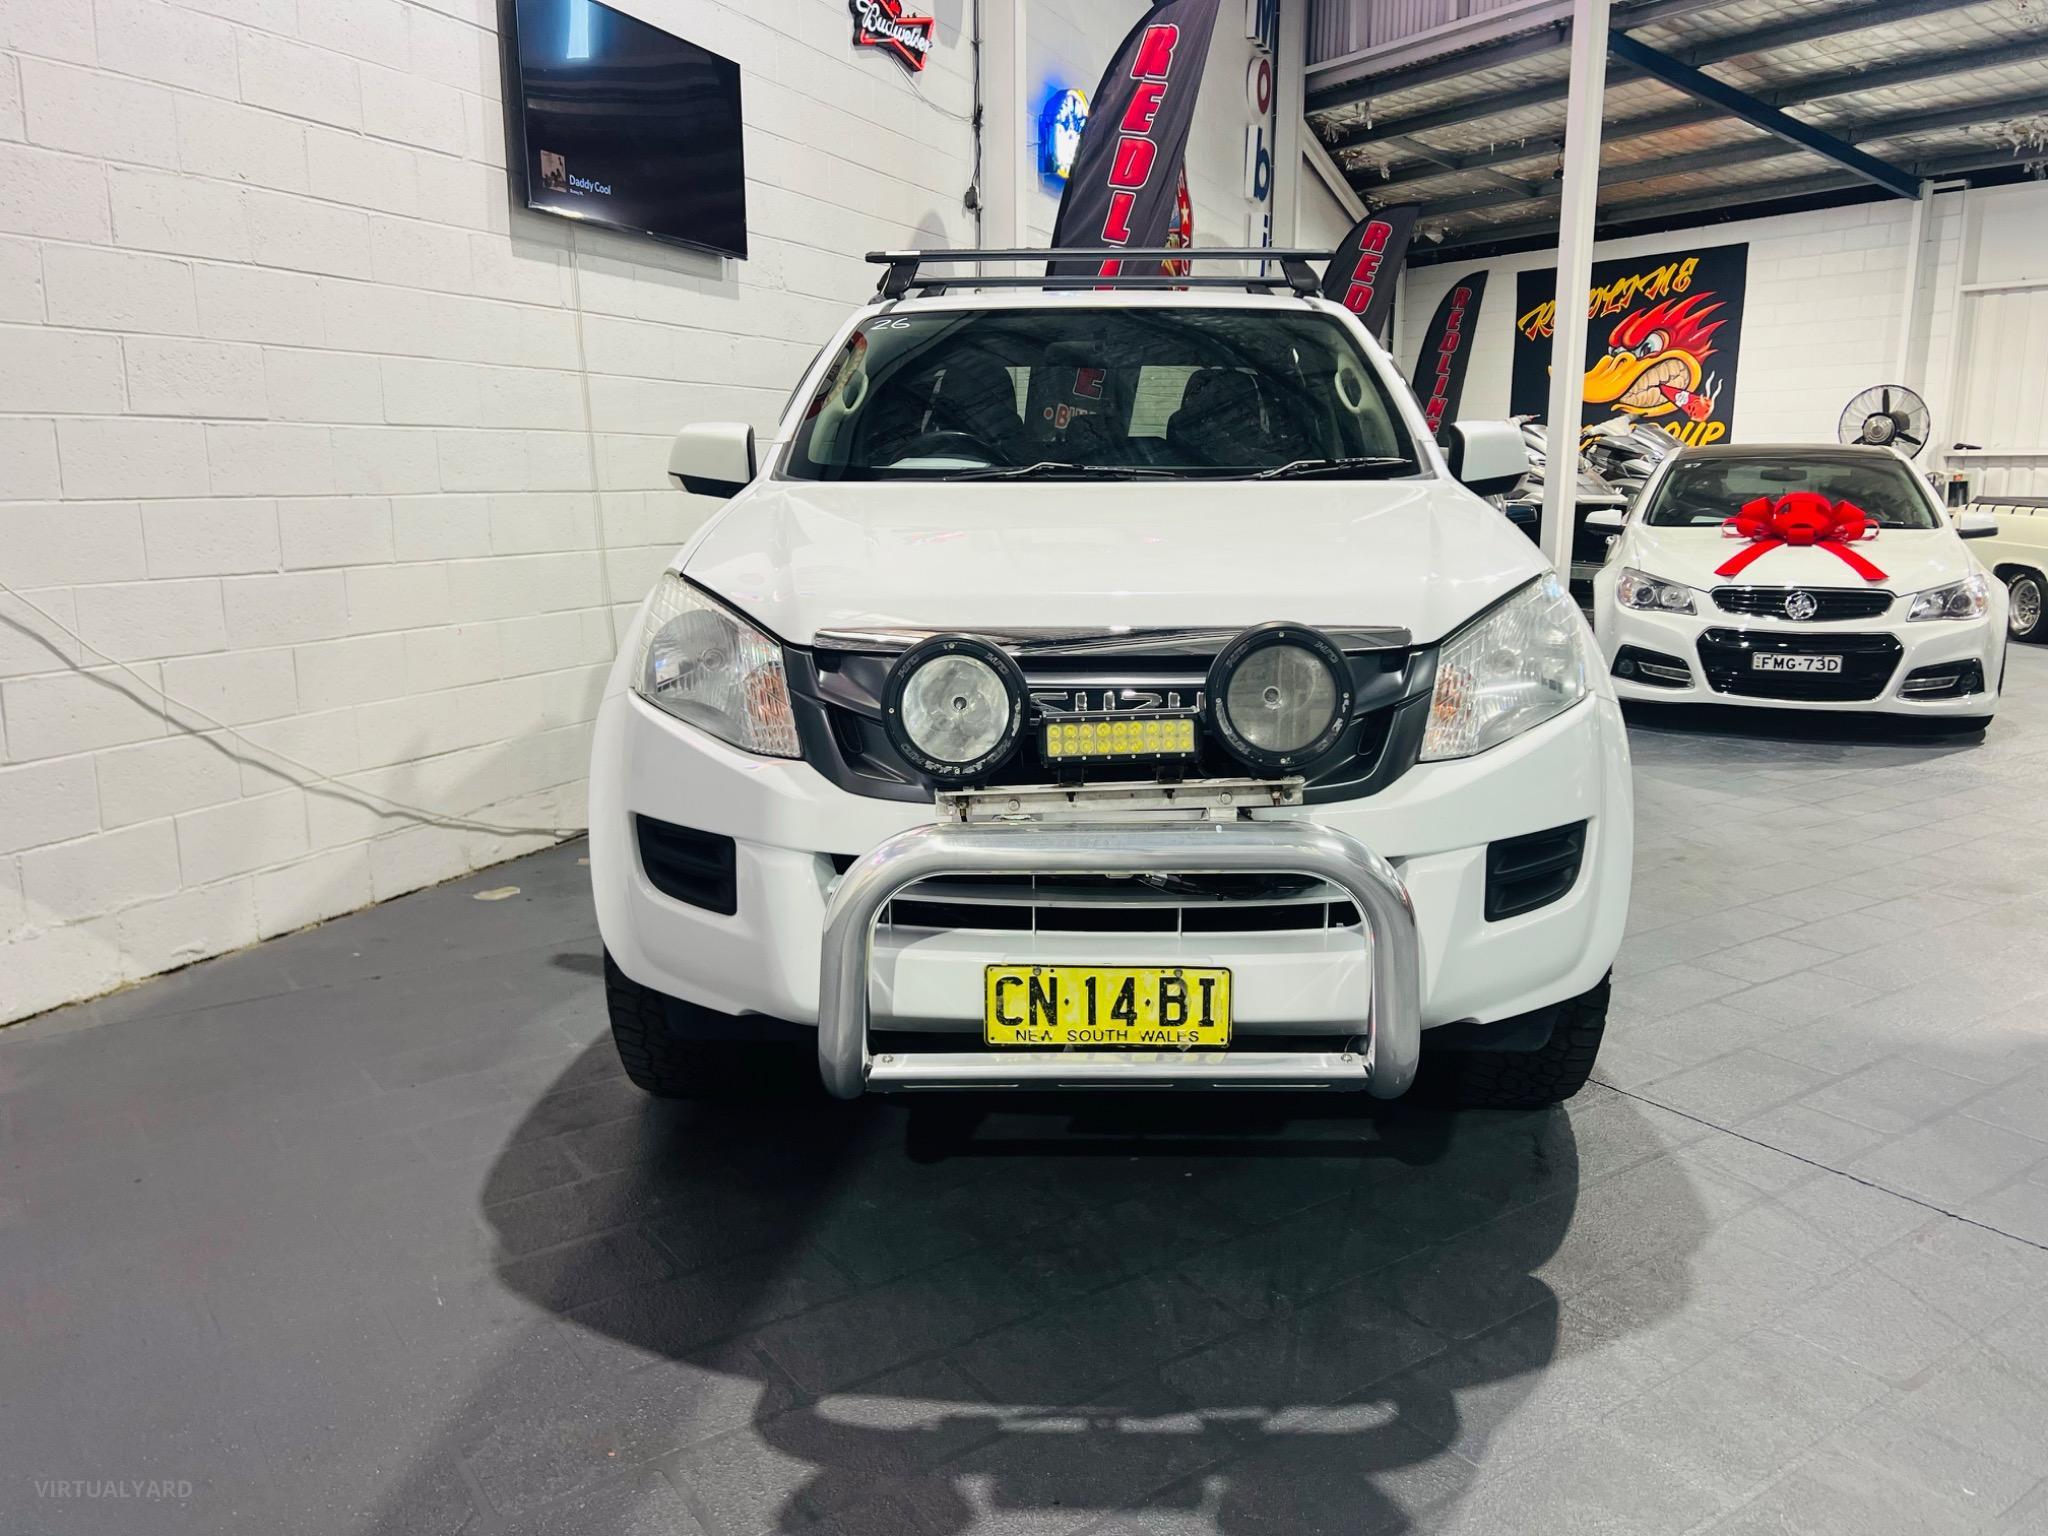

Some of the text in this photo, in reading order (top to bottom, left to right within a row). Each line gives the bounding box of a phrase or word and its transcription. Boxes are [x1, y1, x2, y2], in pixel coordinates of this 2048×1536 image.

[569, 174, 594, 192] Daddy
[594, 181, 612, 195] Cool
[1517, 257, 1699, 341] RLINE
[870, 317, 910, 330] 26
[1067, 1029, 1128, 1041] SOUTH
[1139, 1030, 1200, 1042] WALES
